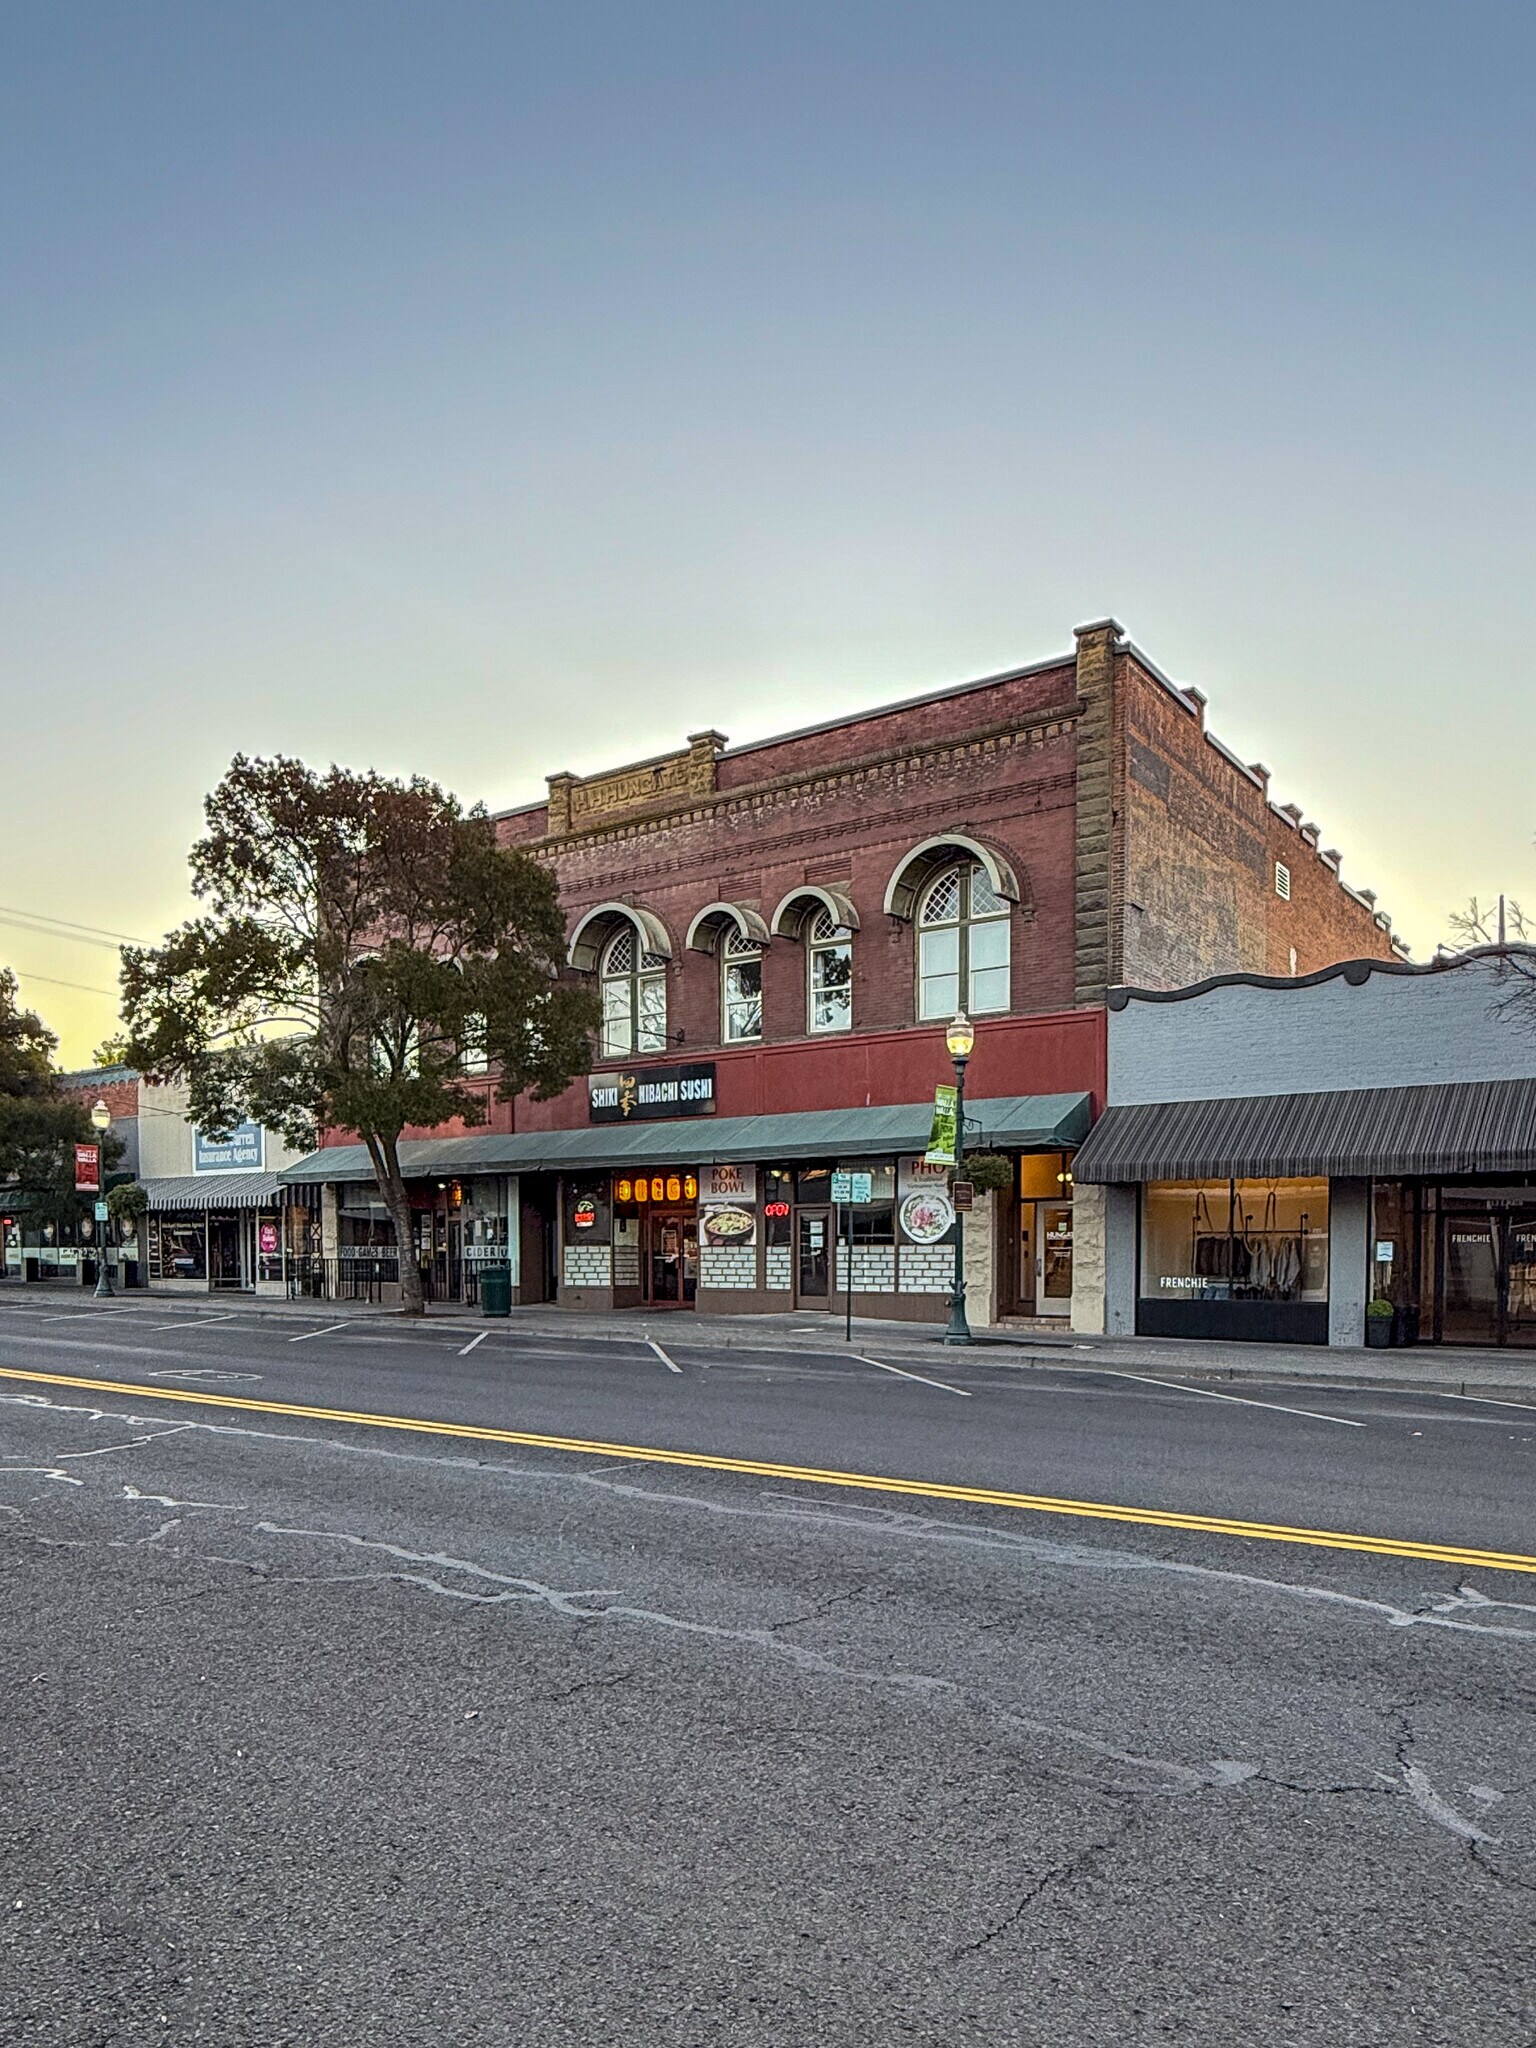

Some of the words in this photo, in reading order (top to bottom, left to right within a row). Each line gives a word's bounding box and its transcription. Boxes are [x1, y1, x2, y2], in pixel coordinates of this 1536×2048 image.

[638, 1082, 678, 1104] HIBACHI
[680, 1078, 712, 1101] SUSHI
[592, 1088, 618, 1108] SHIKI
[199, 1150, 232, 1164] Insurance
[233, 1147, 258, 1163] Agency
[713, 1167, 742, 1181] POKE
[912, 1161, 946, 1175] PHO
[711, 1181, 746, 1194] BOWL
[1452, 1233, 1491, 1243] FRENCHIE
[340, 1246, 356, 1258] FOOD
[382, 1246, 398, 1258] BEER
[466, 1246, 497, 1258] CIDER
[1160, 1276, 1209, 1289] FRENCHIE
